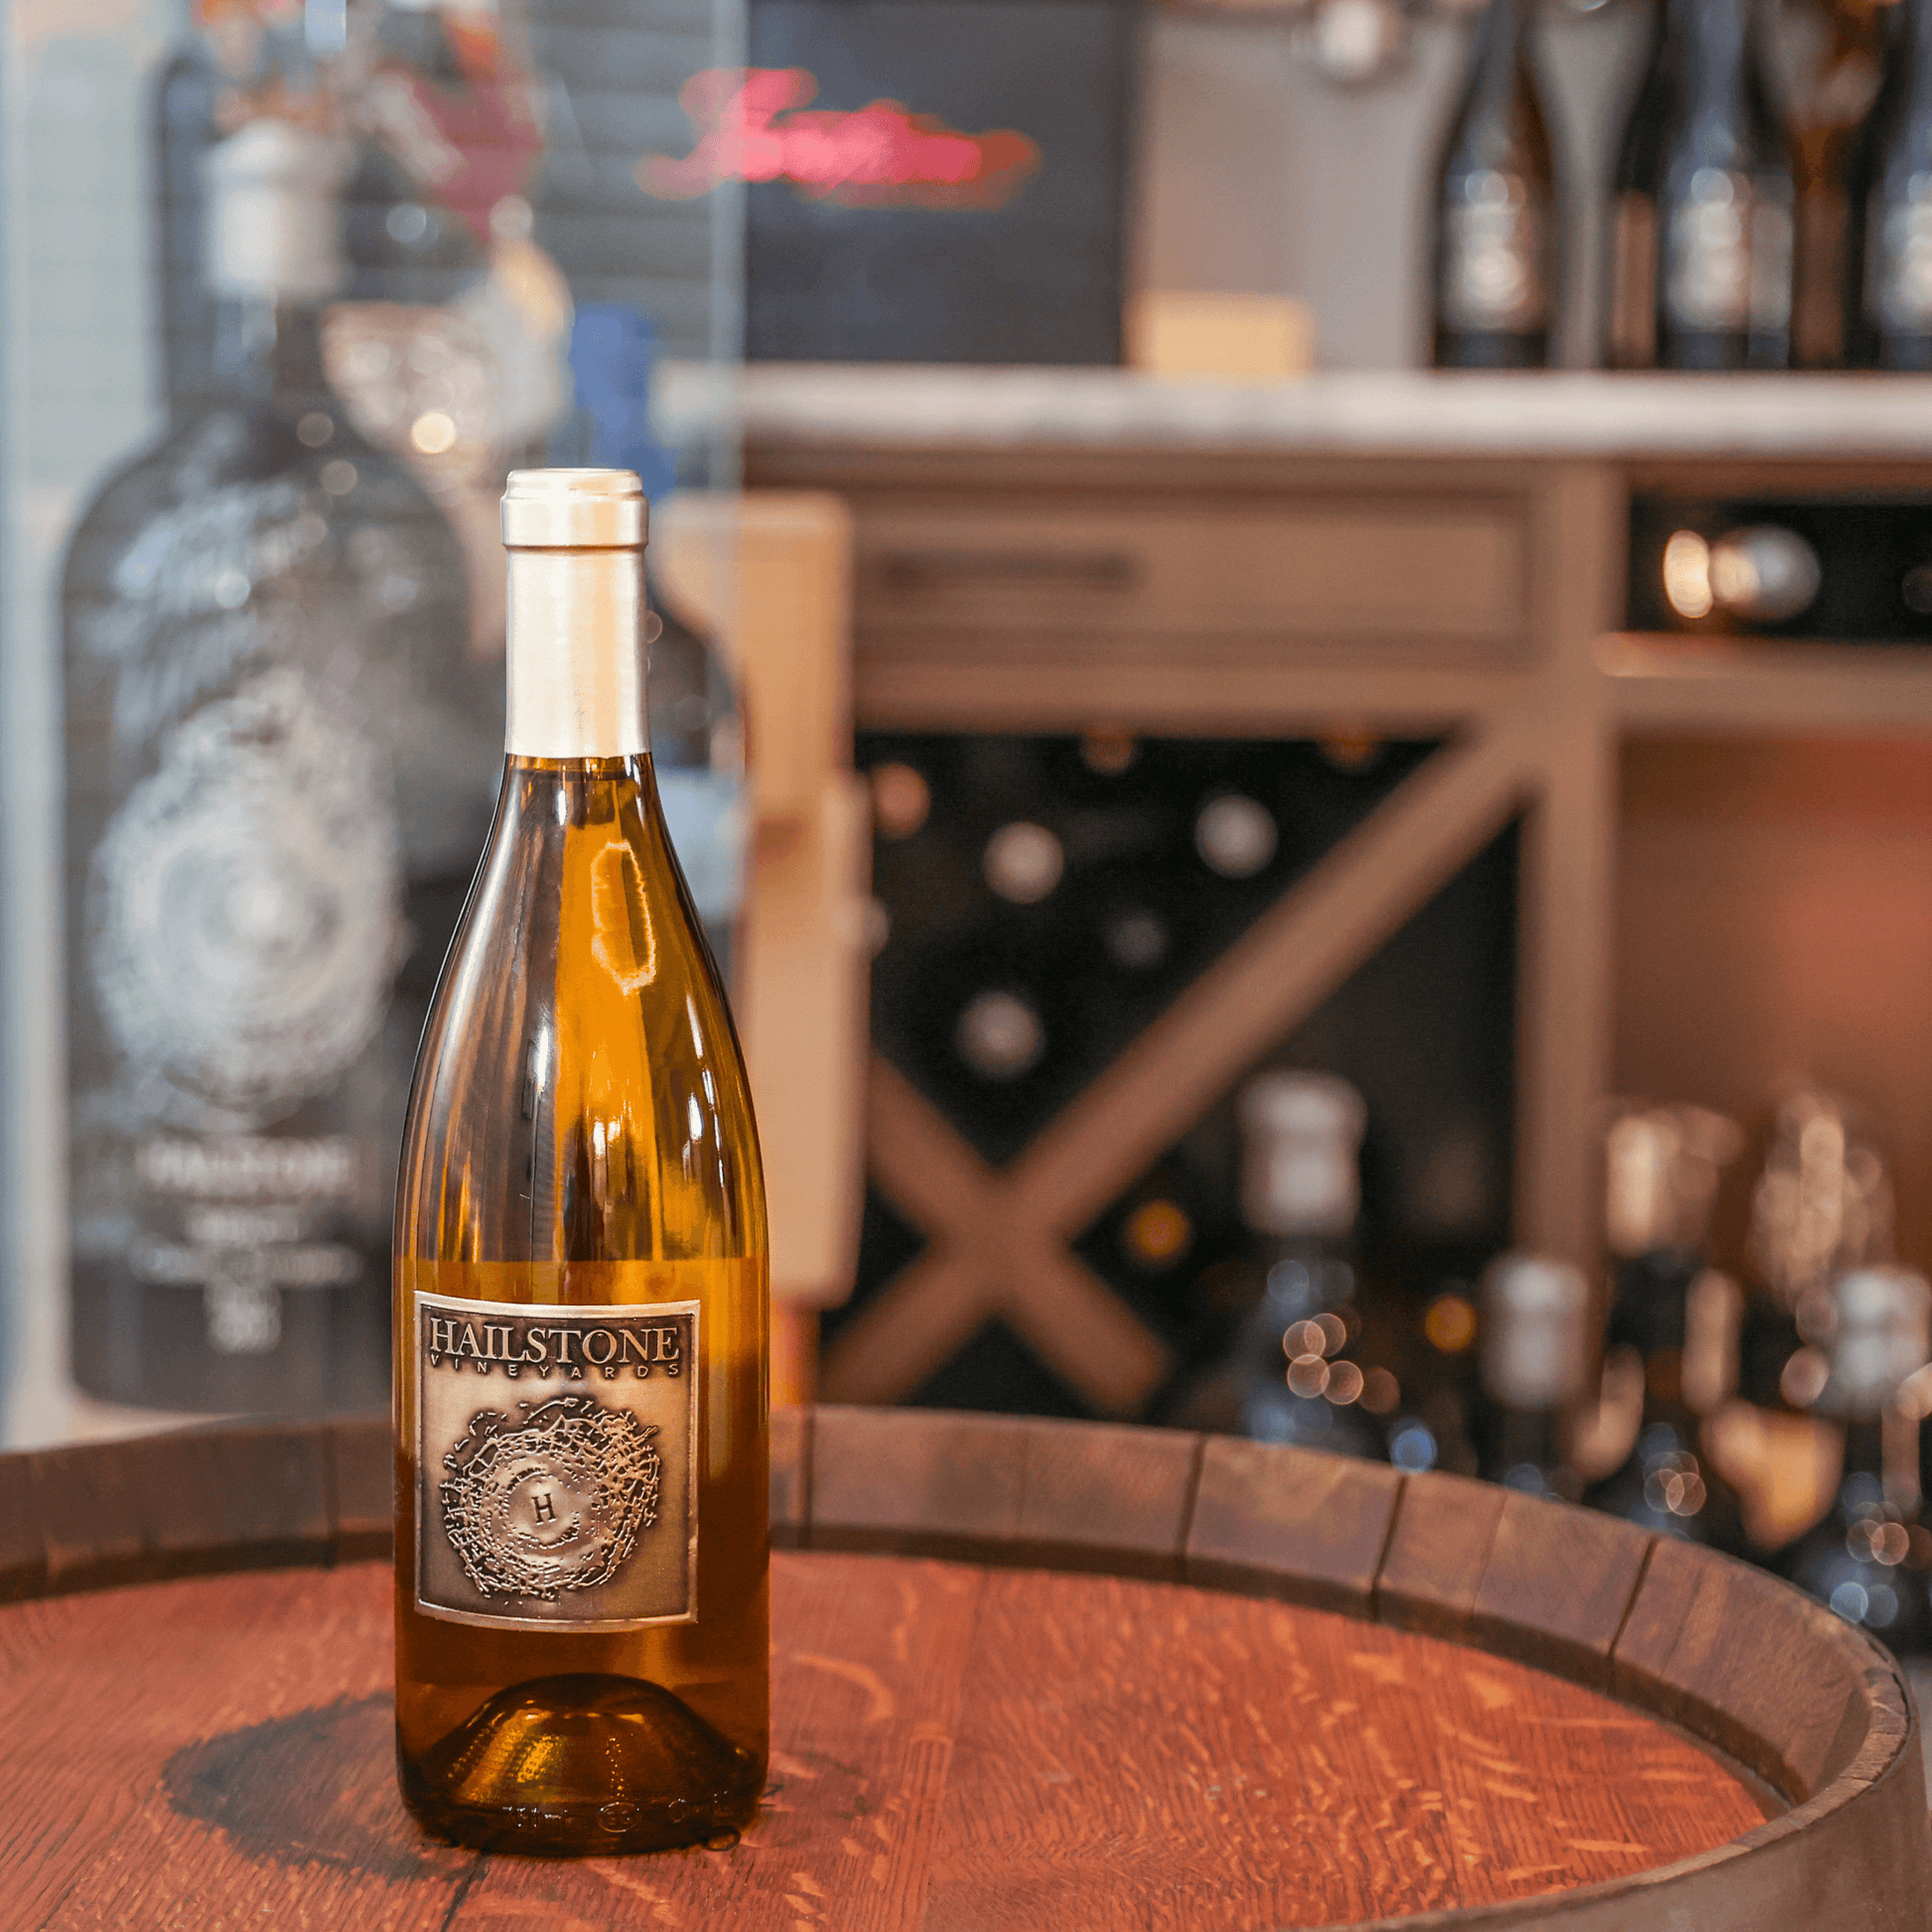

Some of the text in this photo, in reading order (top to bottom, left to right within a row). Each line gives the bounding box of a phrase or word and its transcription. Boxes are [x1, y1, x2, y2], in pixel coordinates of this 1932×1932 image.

[430, 1317, 680, 1365] HAILSTONE
[430, 1354, 680, 1379] VINEYARDS
[531, 1492, 557, 1526] H
